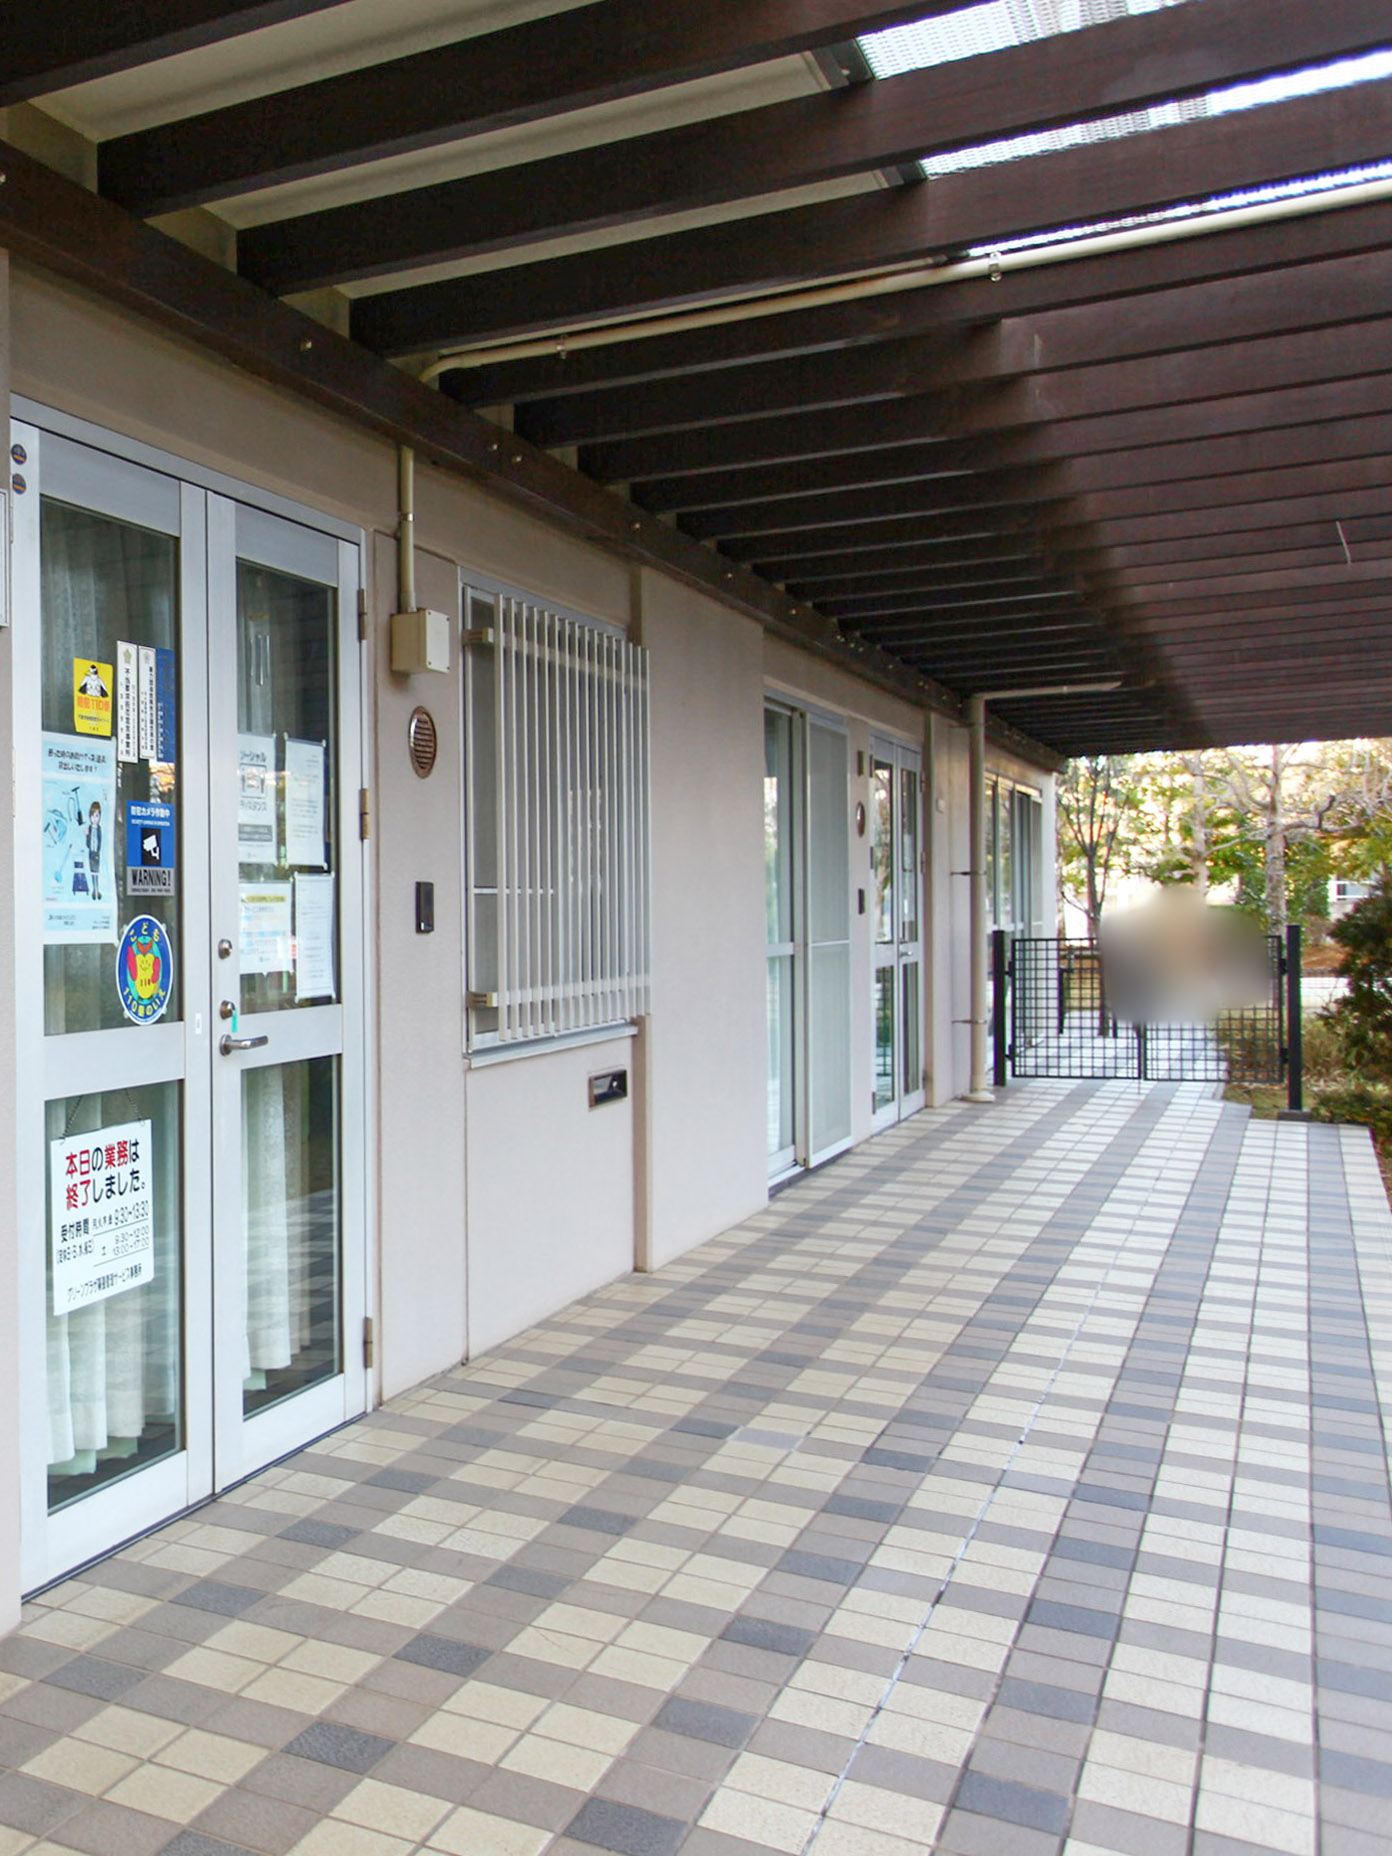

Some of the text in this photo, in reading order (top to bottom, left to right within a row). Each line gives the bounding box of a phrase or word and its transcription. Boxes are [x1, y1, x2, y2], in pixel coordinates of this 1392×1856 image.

[131, 868, 171, 887] WARNING!
[65, 1139, 140, 1179] 本日の業務は
[66, 1168, 145, 1211] 終了しました。
